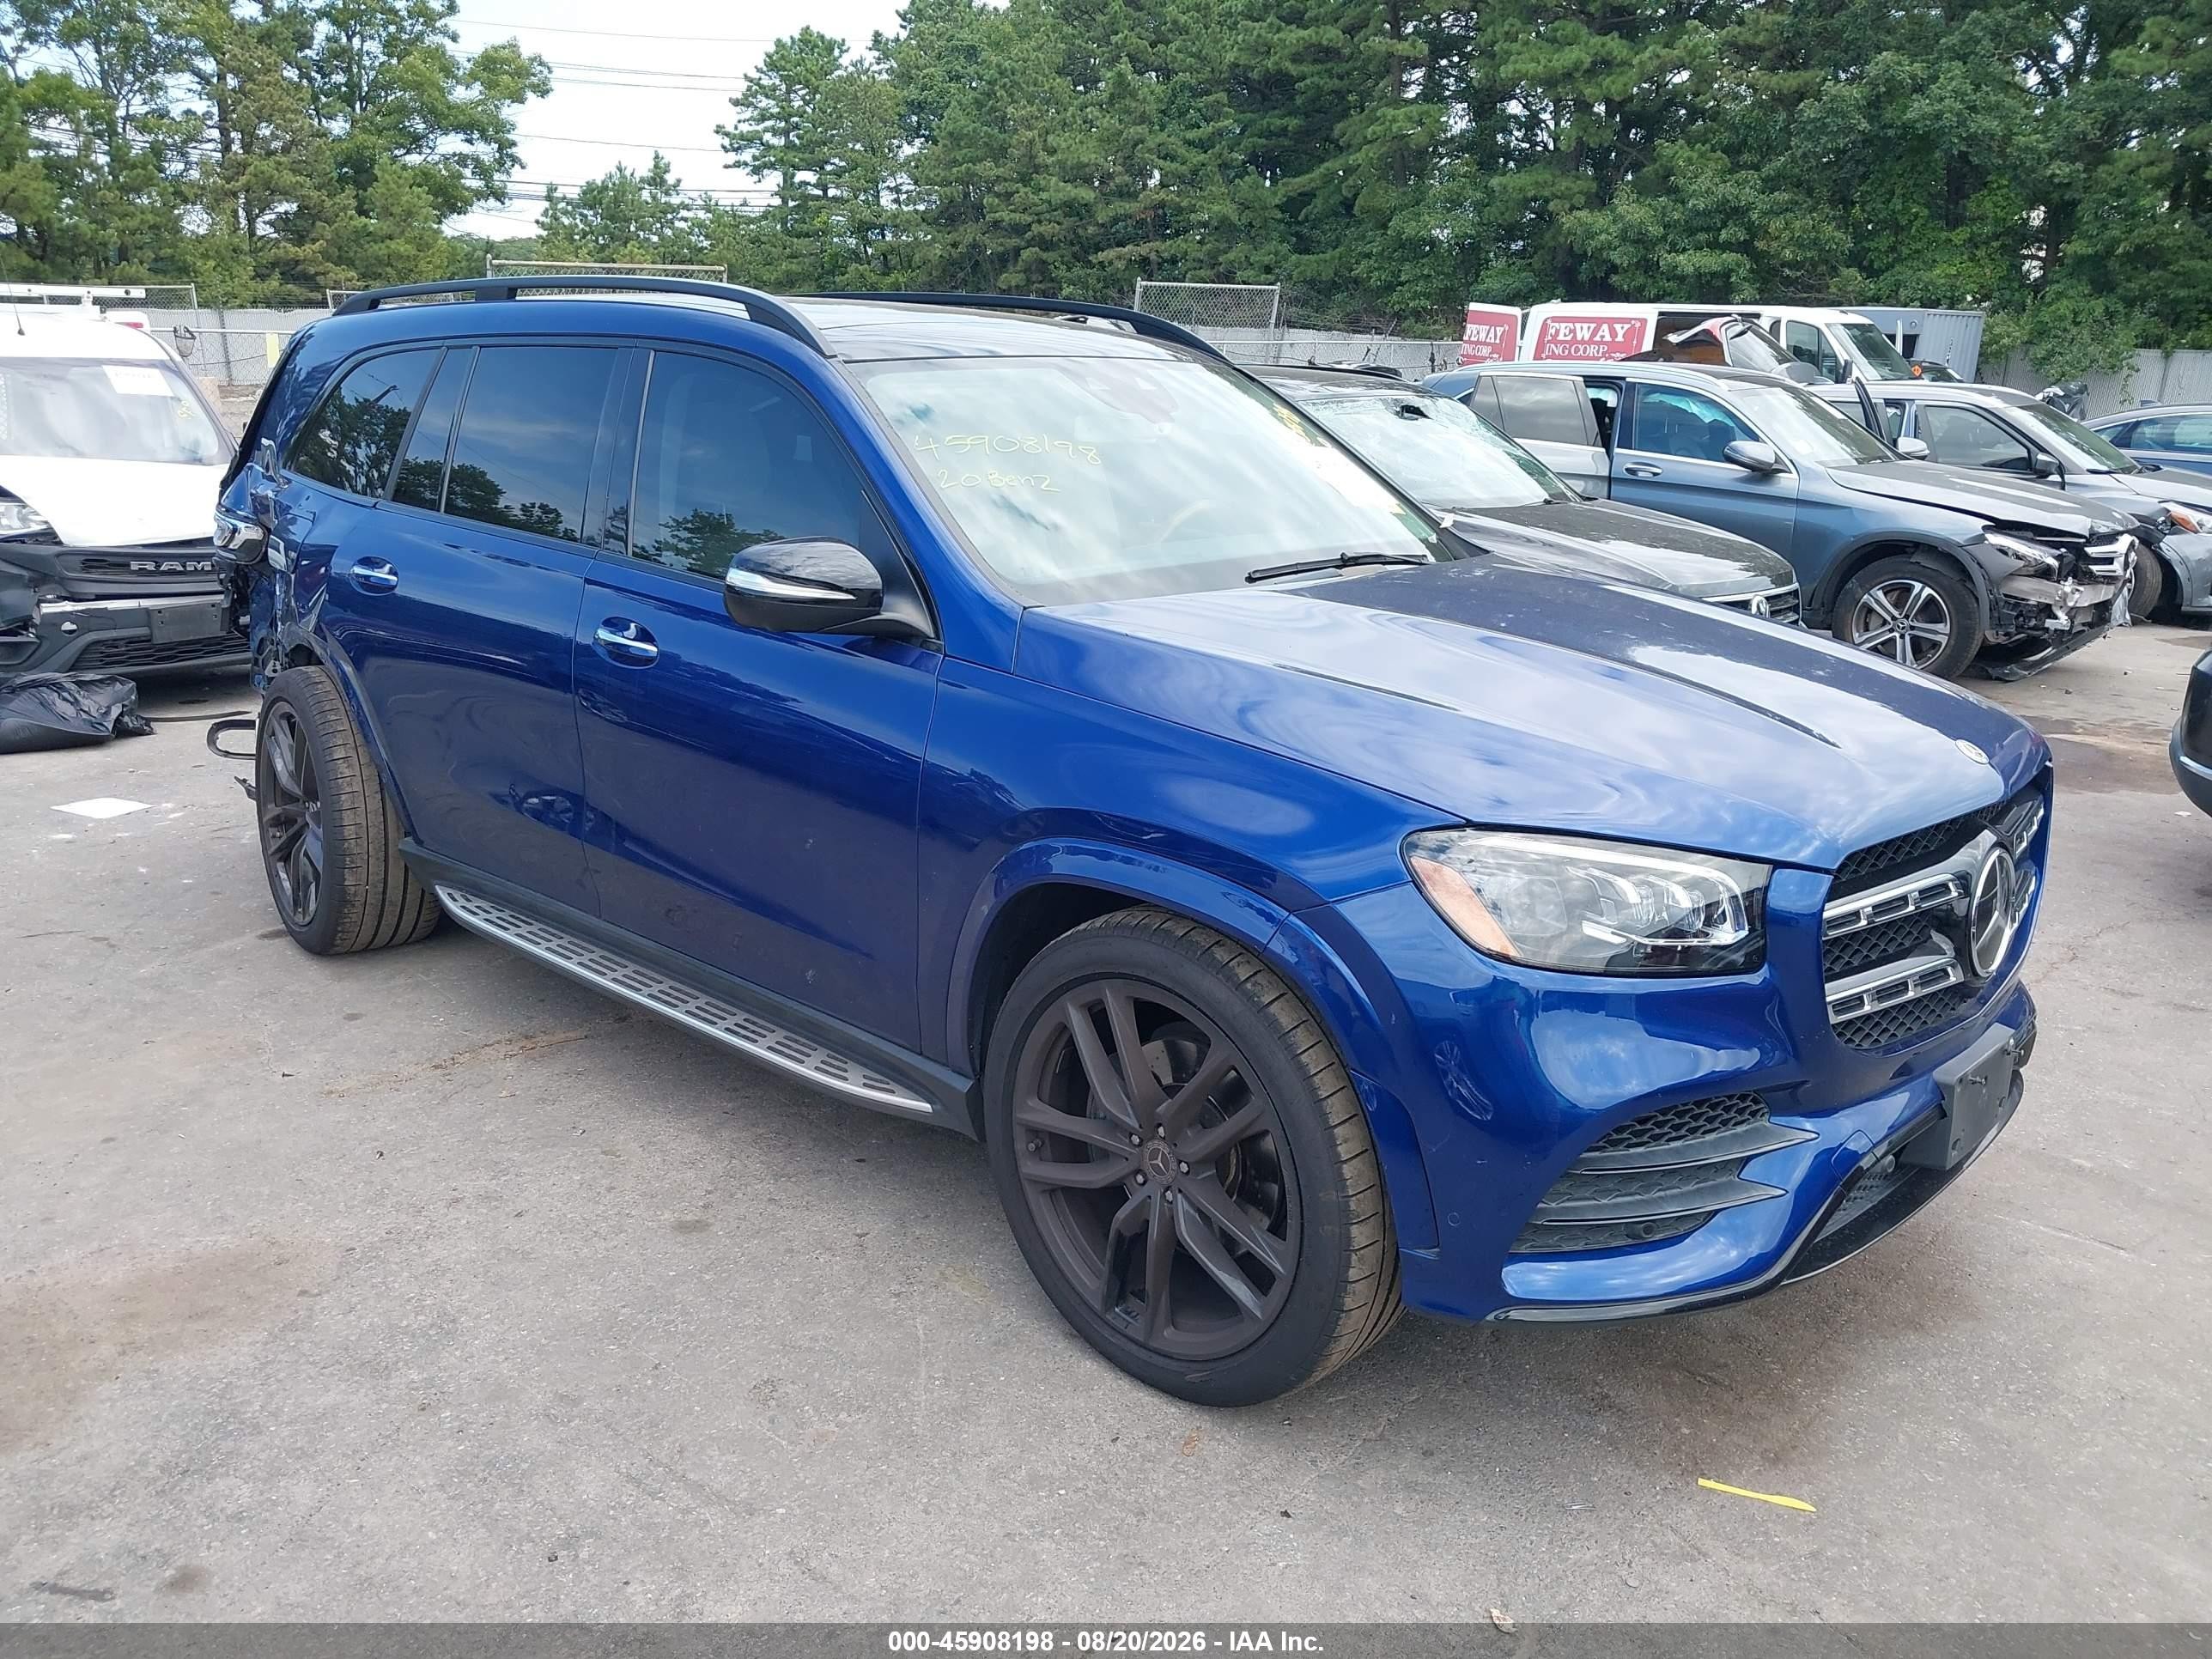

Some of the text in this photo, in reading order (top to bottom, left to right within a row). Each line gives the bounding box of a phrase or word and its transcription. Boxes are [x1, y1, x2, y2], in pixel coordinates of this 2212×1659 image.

[1463, 323, 1504, 343] FEWAY
[1548, 322, 1632, 342] FEWAY
[1571, 344, 1609, 357] CORP.
[914, 434, 1101, 465] 45908198
[938, 469, 981, 489] 20
[131, 561, 212, 571] RAM
